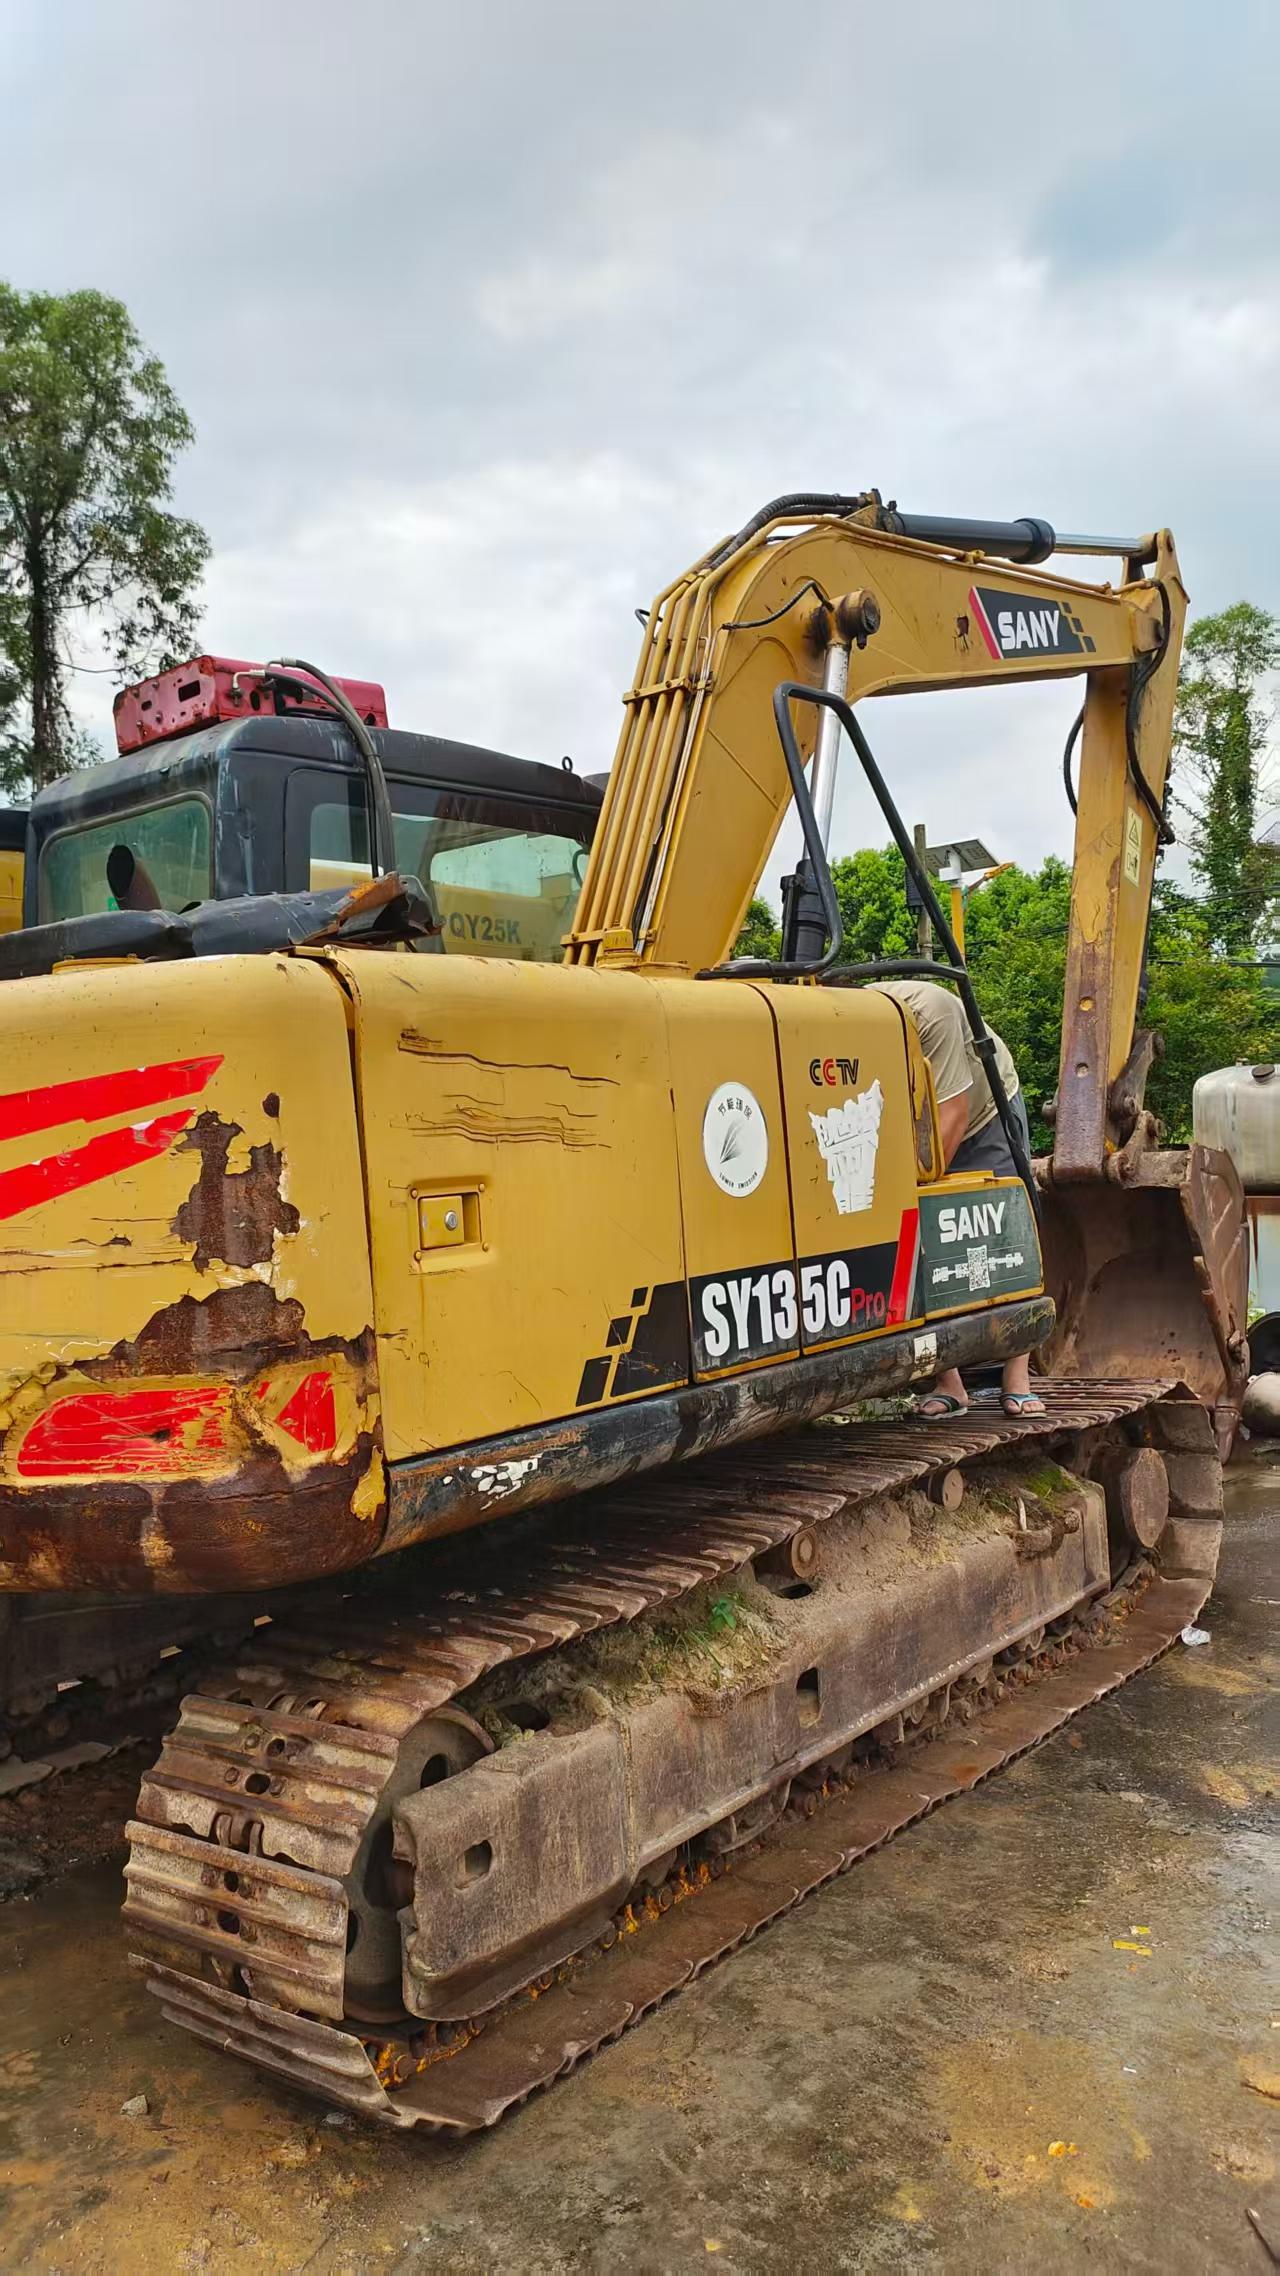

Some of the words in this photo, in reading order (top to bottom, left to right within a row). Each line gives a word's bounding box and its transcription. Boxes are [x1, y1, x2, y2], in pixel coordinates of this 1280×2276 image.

[998, 610, 1059, 650] SANY
[809, 1058, 859, 1086] CCTV
[938, 1202, 1005, 1243] SANY
[701, 1259, 850, 1357] SY135C
[851, 1287, 886, 1323] Pro
